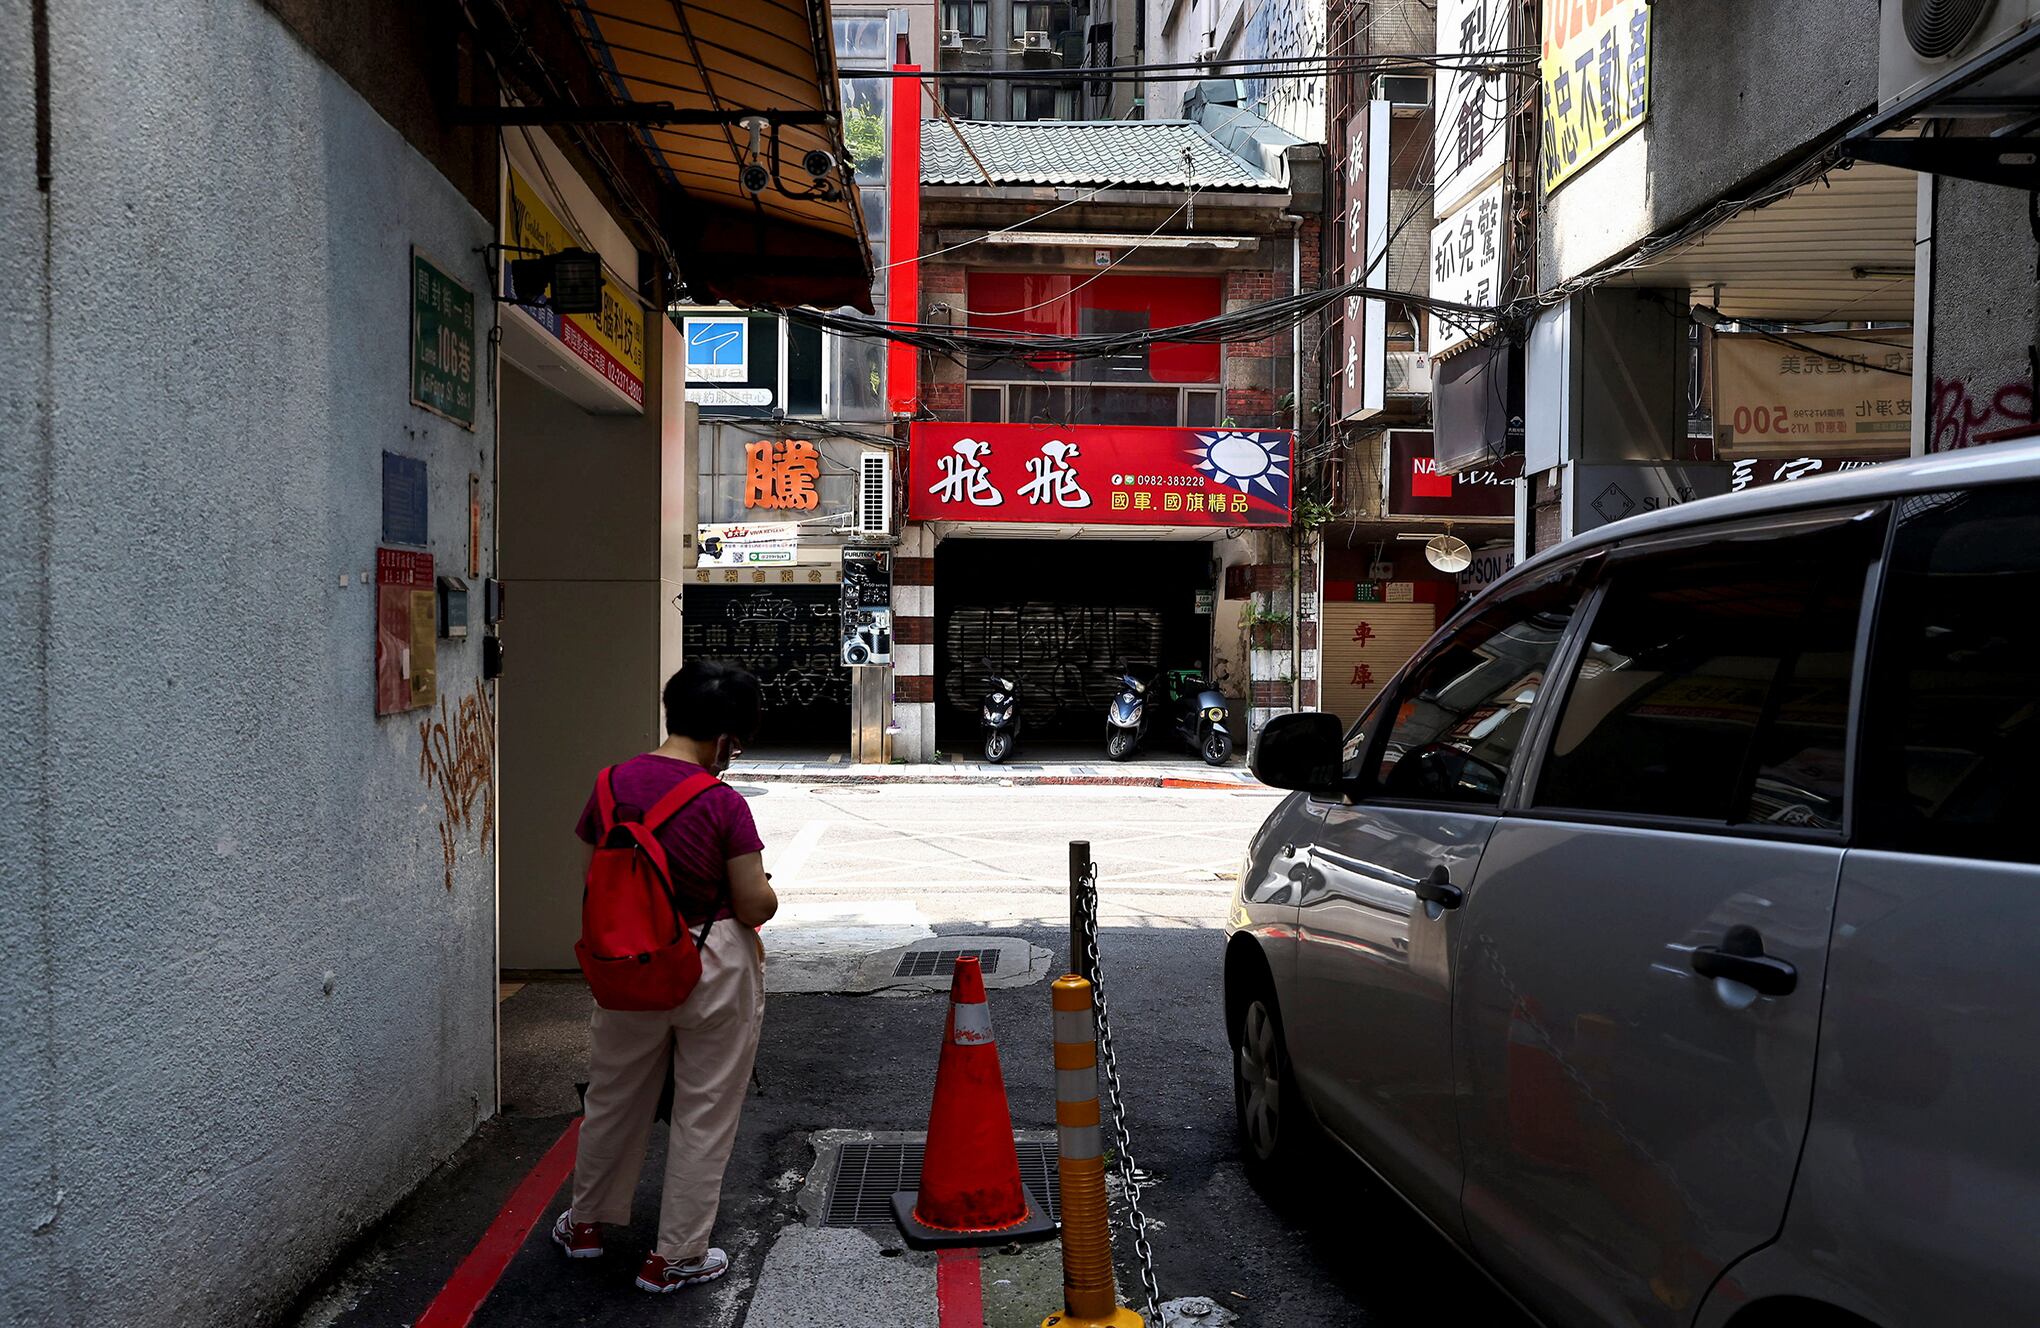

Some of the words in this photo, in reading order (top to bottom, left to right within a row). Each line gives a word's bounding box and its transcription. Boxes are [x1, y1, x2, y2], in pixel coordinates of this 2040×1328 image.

[438, 324, 471, 383] 106巷
[1414, 458, 1443, 474] NA
[1137, 475, 1205, 488] 0982-383228
[1461, 557, 1501, 585] EPSON
